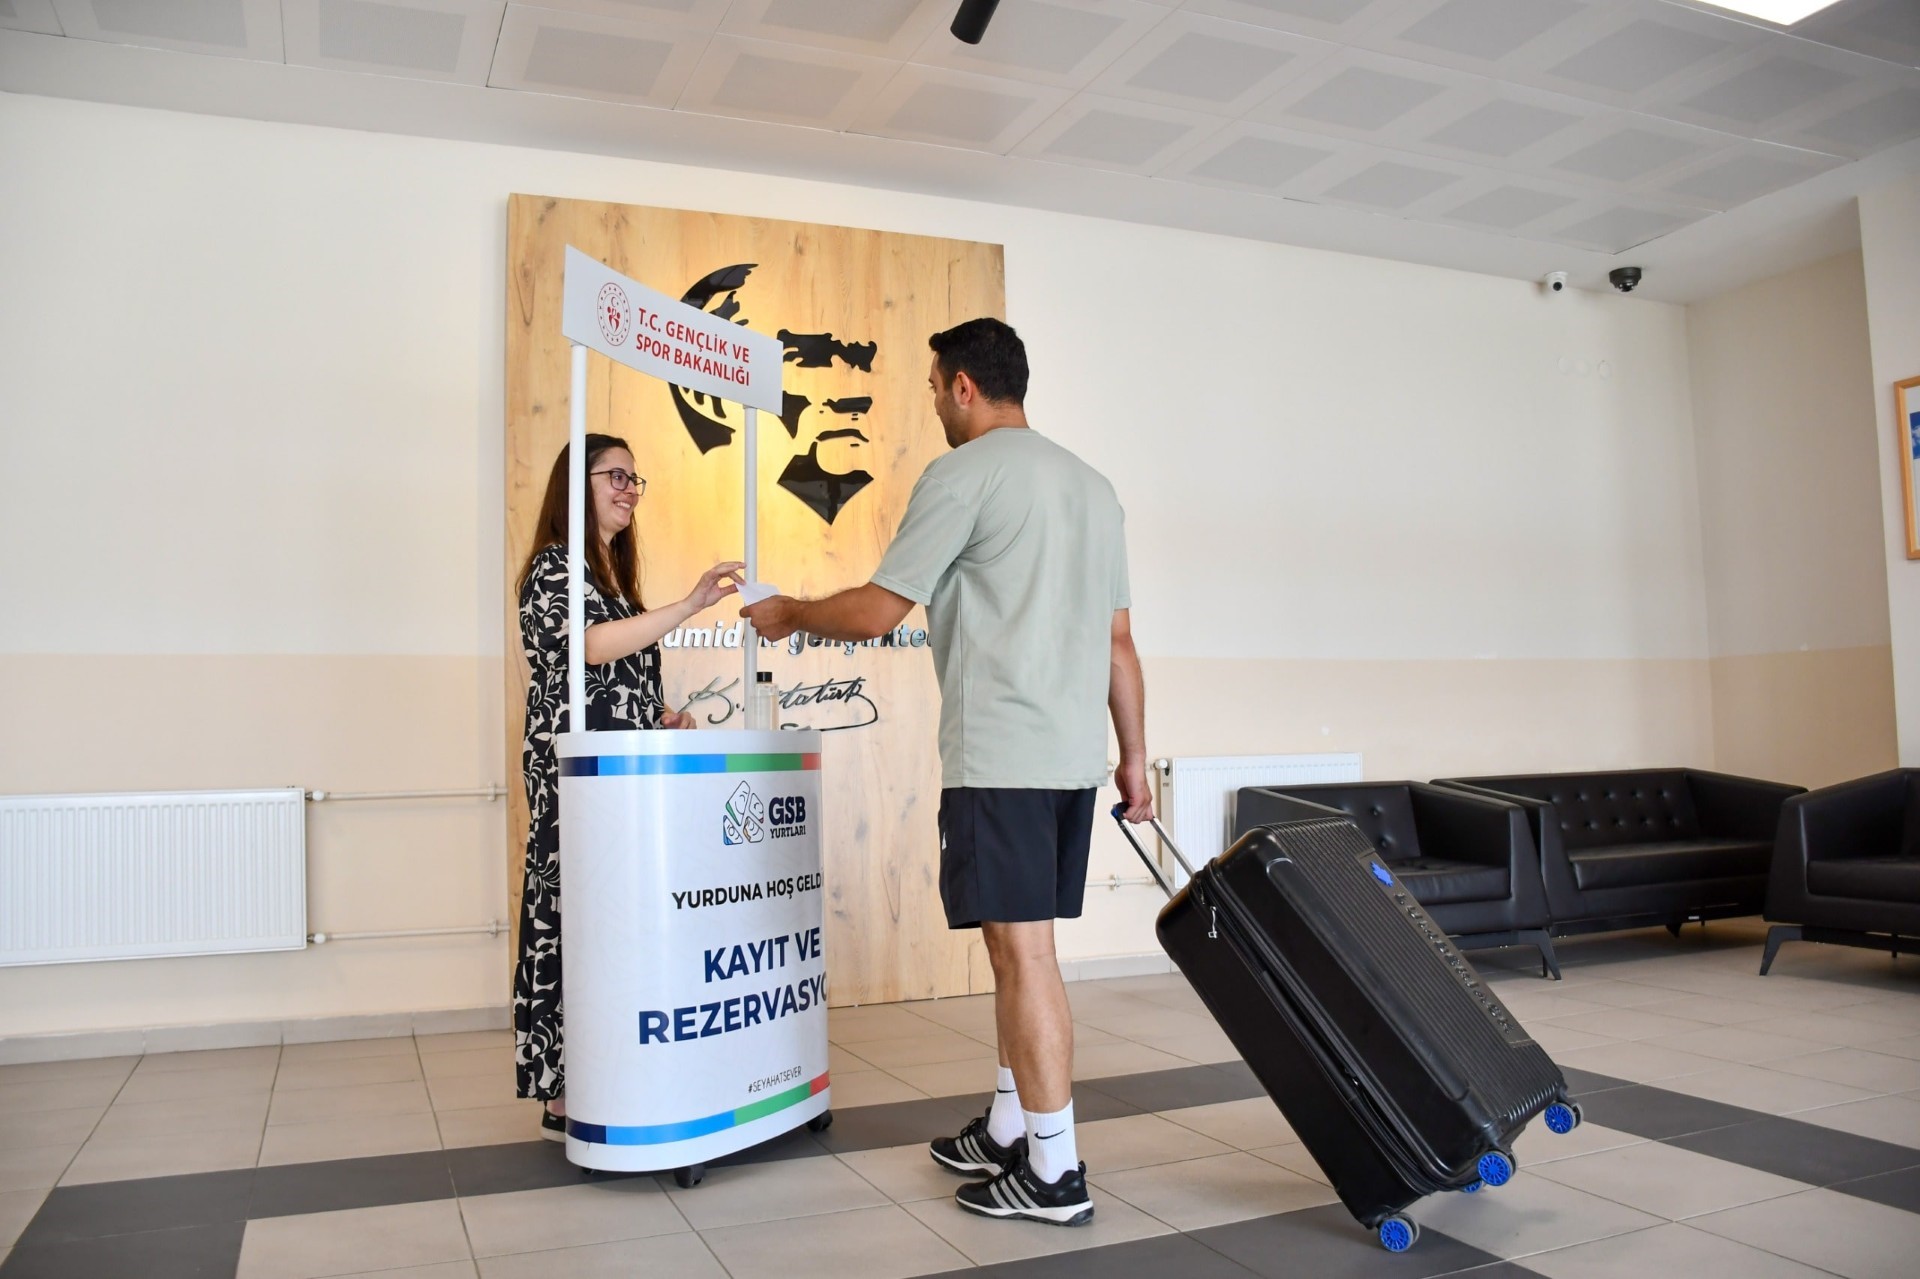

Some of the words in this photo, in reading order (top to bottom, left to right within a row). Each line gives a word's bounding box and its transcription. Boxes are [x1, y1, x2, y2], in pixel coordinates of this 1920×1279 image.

[638, 307, 661, 333] T.C.
[666, 320, 727, 356] GENÇLİK
[732, 343, 750, 364] VE
[636, 333, 670, 361] SPOR
[674, 348, 750, 386] BAKANLIĞI
[768, 796, 806, 826] GSB
[770, 825, 806, 839] YURTLARI
[671, 883, 763, 910] YURDUNA
[766, 876, 794, 900] HOŞ
[704, 935, 789, 984] KAYIT
[794, 927, 821, 962] VE
[748, 1065, 802, 1093] #SEYAHATSEVER
